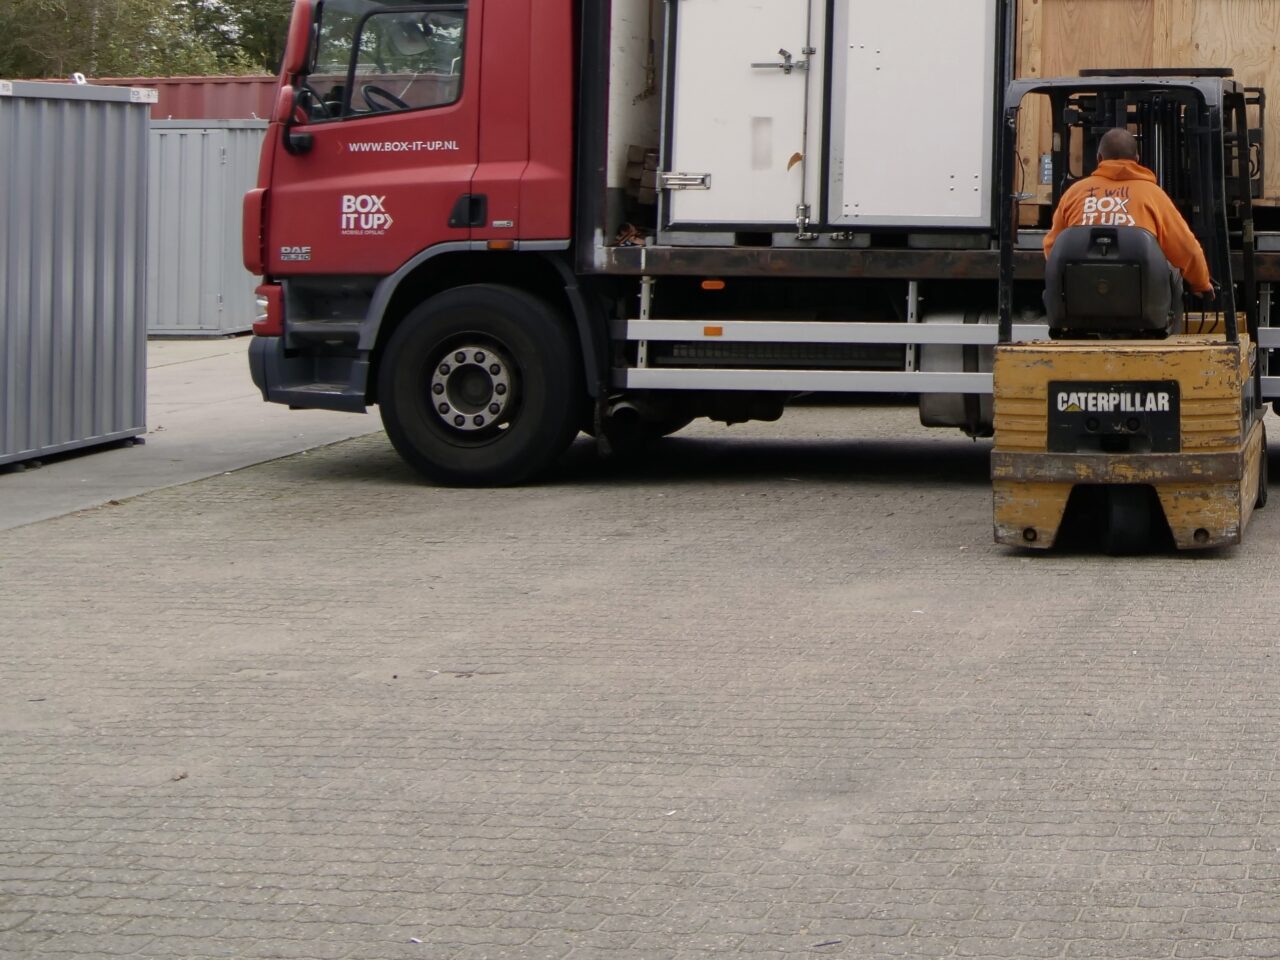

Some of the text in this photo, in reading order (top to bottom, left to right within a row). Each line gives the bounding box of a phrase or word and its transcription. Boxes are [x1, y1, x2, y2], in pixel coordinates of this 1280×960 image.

[349, 140, 460, 152] WWW.BOX-IT-UP.NL
[342, 194, 386, 213] BOX
[1083, 196, 1129, 213] BOX
[341, 213, 385, 229] IT UP
[1081, 213, 1127, 225] IT UP
[281, 246, 311, 254] DAF
[1057, 392, 1170, 412] CATERPILLAR
